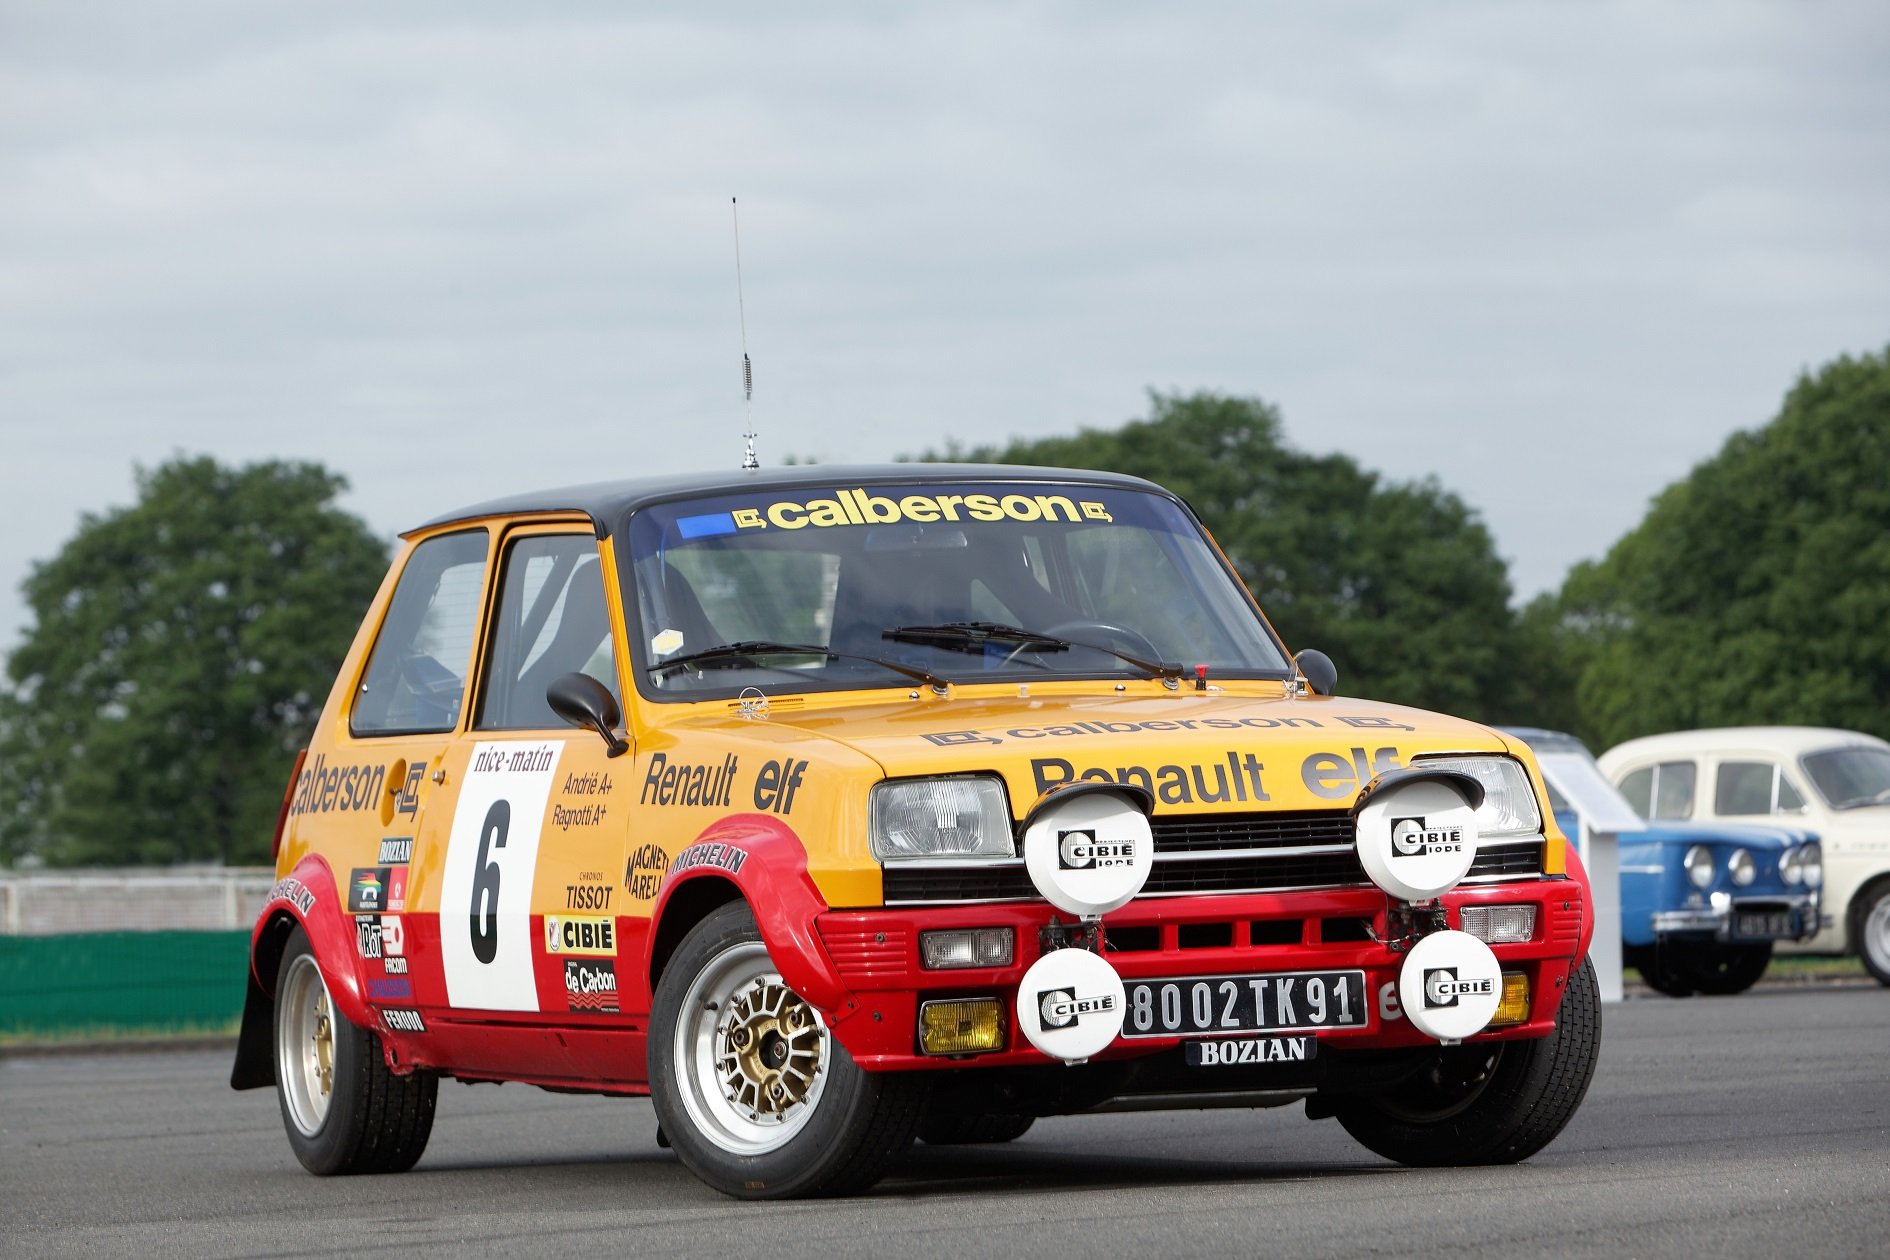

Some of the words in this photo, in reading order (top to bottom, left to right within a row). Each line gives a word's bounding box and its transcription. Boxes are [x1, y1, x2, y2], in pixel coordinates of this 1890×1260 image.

[767, 487, 1082, 529] calberson
[1006, 716, 1325, 739] calberson
[563, 772, 599, 795] Andrié
[598, 773, 613, 795] A+
[640, 752, 738, 807] Renault
[754, 757, 809, 815] elf
[552, 804, 593, 832] Ragnotti
[592, 804, 606, 826] A+
[379, 840, 412, 862] BOZIAN
[672, 842, 747, 875] MICHELIN
[470, 799, 511, 965] 6
[579, 871, 604, 881] CHRONOS
[566, 885, 613, 910] TISSOT
[563, 919, 613, 949] CIBIÉ
[565, 966, 579, 994] de
[579, 966, 616, 994] Carbon
[382, 1010, 425, 1032] FERODO
[1199, 1037, 1307, 1067] BOZIAN
